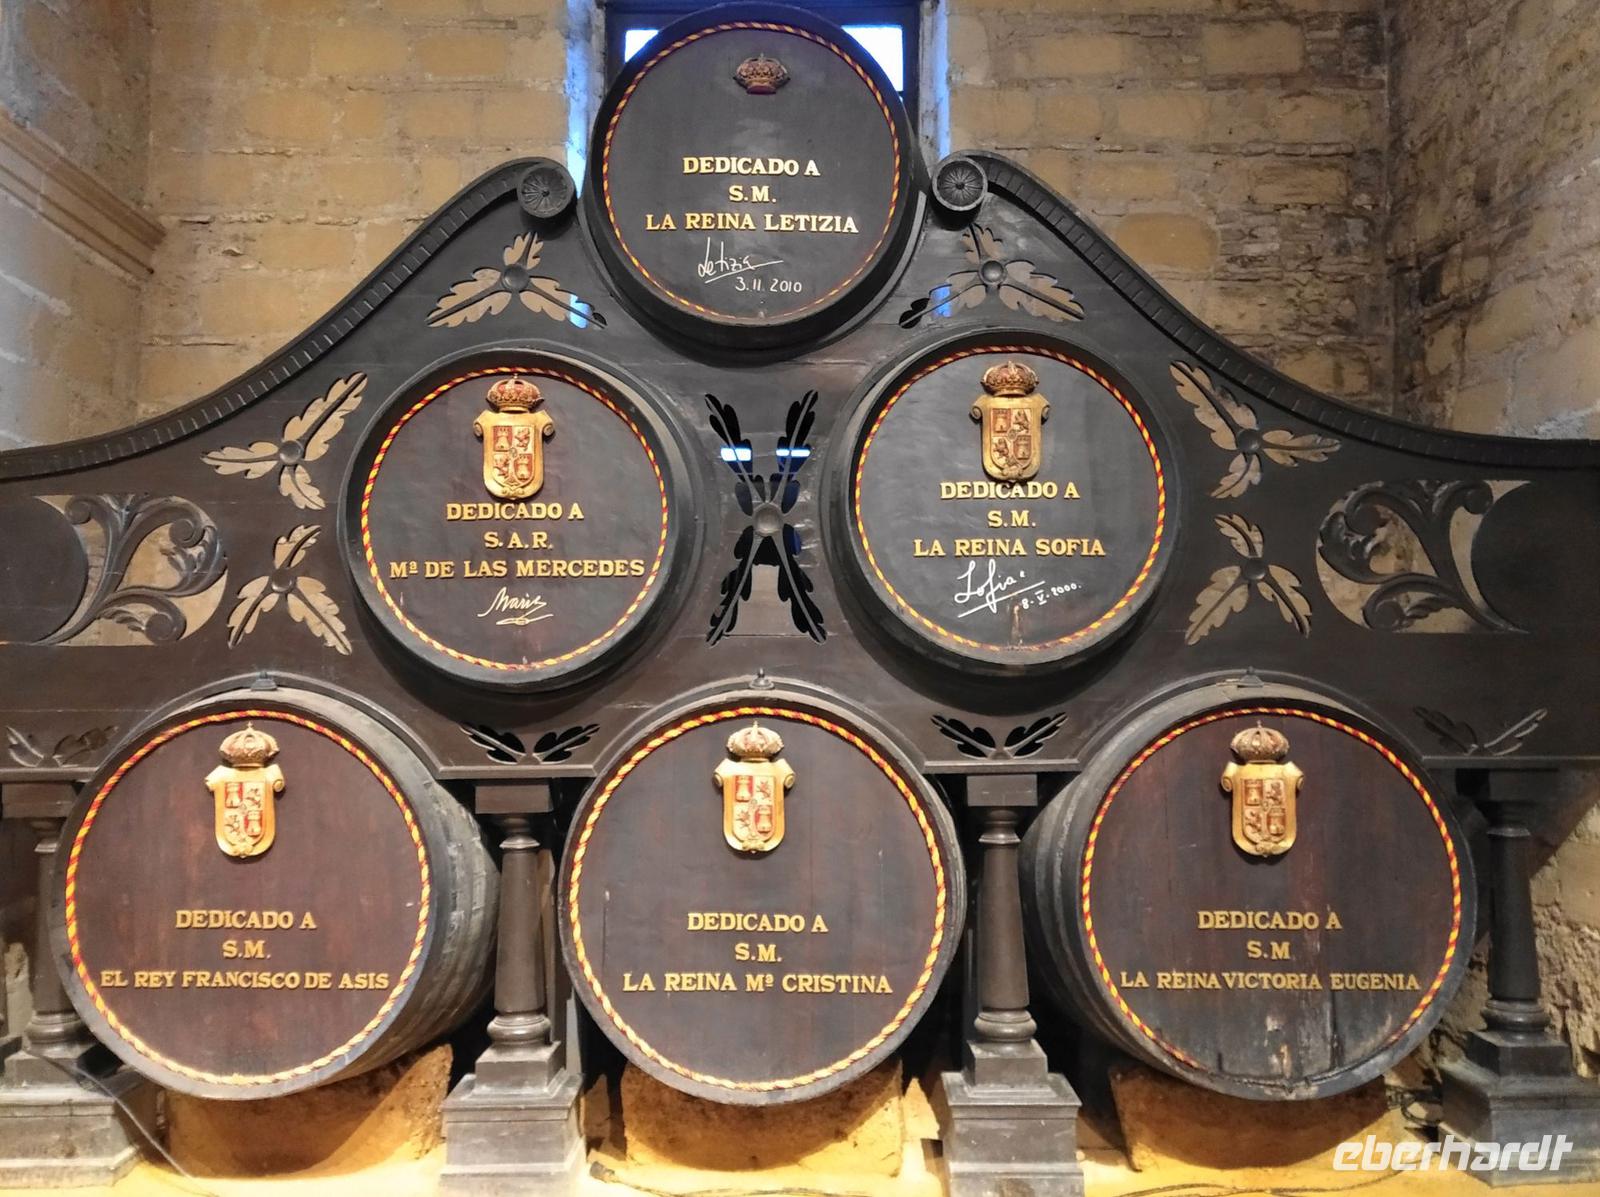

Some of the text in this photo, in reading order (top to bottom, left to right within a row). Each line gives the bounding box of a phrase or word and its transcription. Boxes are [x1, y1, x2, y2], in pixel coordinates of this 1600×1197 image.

[682, 156, 821, 177] DEDICADO A
[728, 185, 777, 203] S.M.
[645, 213, 859, 234] LA REINA LETIZIA
[940, 481, 1081, 499] DEDICADO A
[446, 502, 585, 521] DEDICADO A
[987, 510, 1037, 527] S.M.
[484, 531, 554, 549] S.A.R.
[913, 538, 1106, 557] LA REINA SOFIA
[390, 559, 645, 579] Mª DE LAS MERCEDES
[175, 909, 317, 930] DEDICADO A
[687, 912, 829, 933] DEDICADO A
[1197, 910, 1343, 930] DEDICADO A
[222, 940, 272, 959] S.M.
[734, 943, 783, 963] S.M.
[100, 970, 390, 990] EL REY FRANCISCO DE ASIS
[622, 973, 893, 994] LA REINA Mª CRISTINA
[1120, 971, 1421, 991] LA REINA VICTORIA EUGENIA
